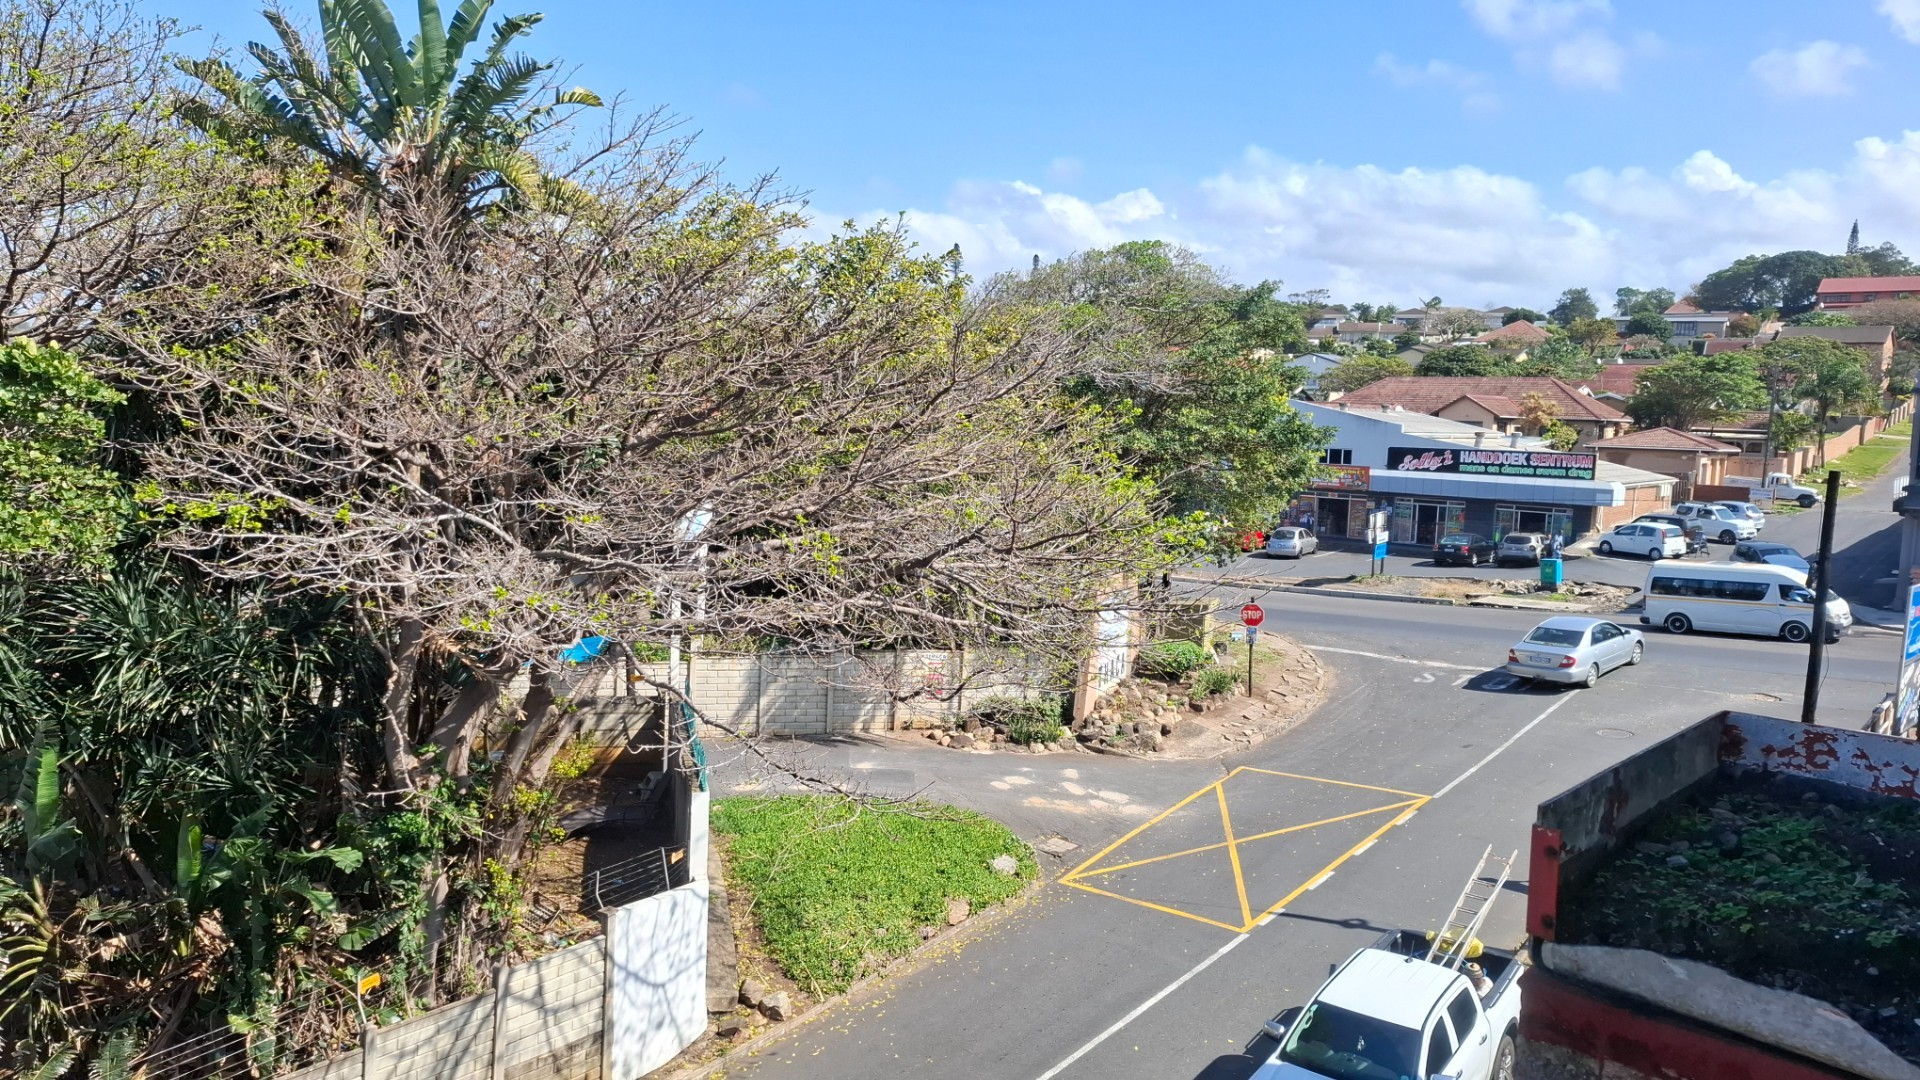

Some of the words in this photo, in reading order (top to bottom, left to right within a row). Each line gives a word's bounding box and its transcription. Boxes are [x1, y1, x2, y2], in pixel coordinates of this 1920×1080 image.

[1398, 450, 1453, 471] Solly's
[1460, 451, 1528, 466] HANDDOEK
[1530, 453, 1593, 468] SENTRUM
[1487, 465, 1499, 473] en
[1501, 465, 1535, 475] dames
[1242, 610, 1262, 620] STOP
